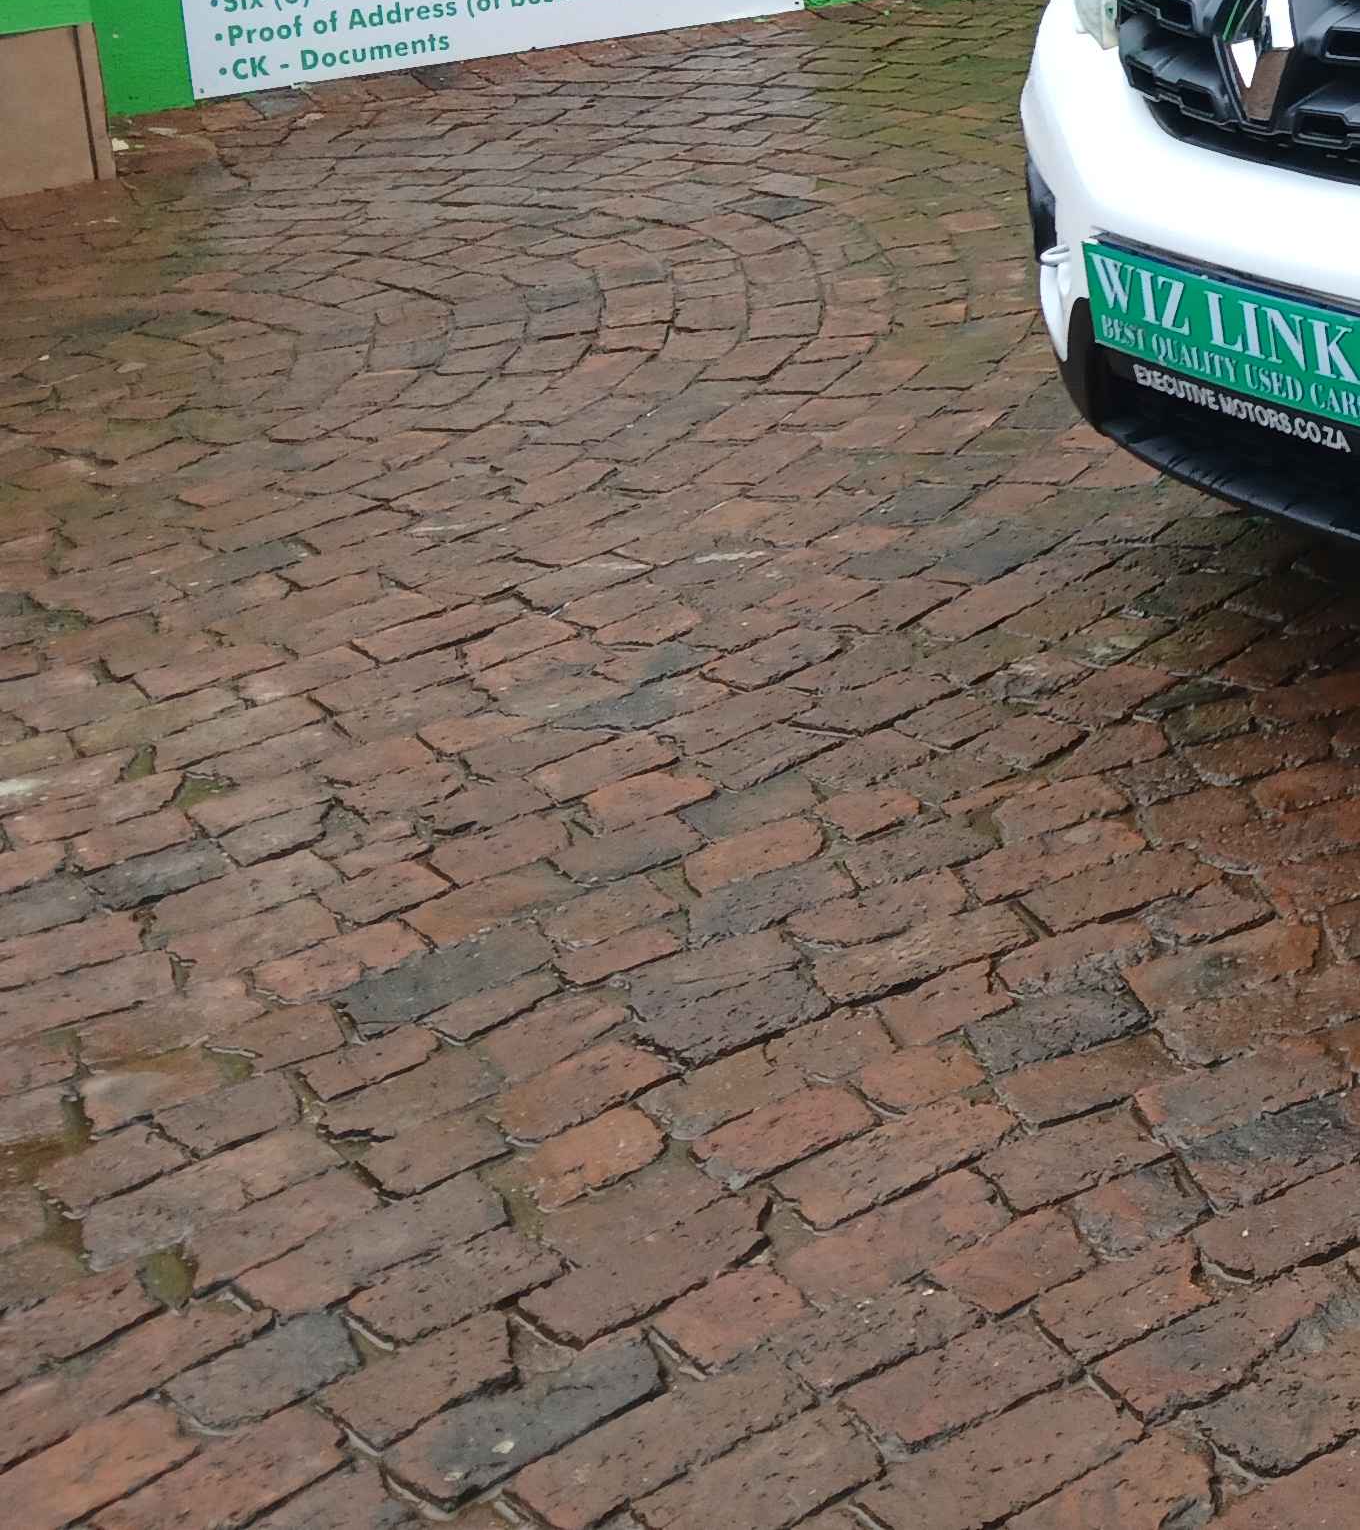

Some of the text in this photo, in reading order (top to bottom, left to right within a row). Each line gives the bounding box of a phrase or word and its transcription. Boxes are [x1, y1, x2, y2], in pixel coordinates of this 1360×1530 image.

[228, 15, 303, 46] Proof
[313, 10, 337, 35] of
[349, 2, 457, 30] Address
[232, 55, 270, 80] CK
[300, 33, 450, 71] Documents
[1088, 252, 1191, 335] WIZ
[1101, 314, 1147, 348] BEST
[1152, 332, 1238, 383] QUALITY
[1244, 363, 1305, 401] USED
[1133, 364, 1219, 412] EXECUTIVE
